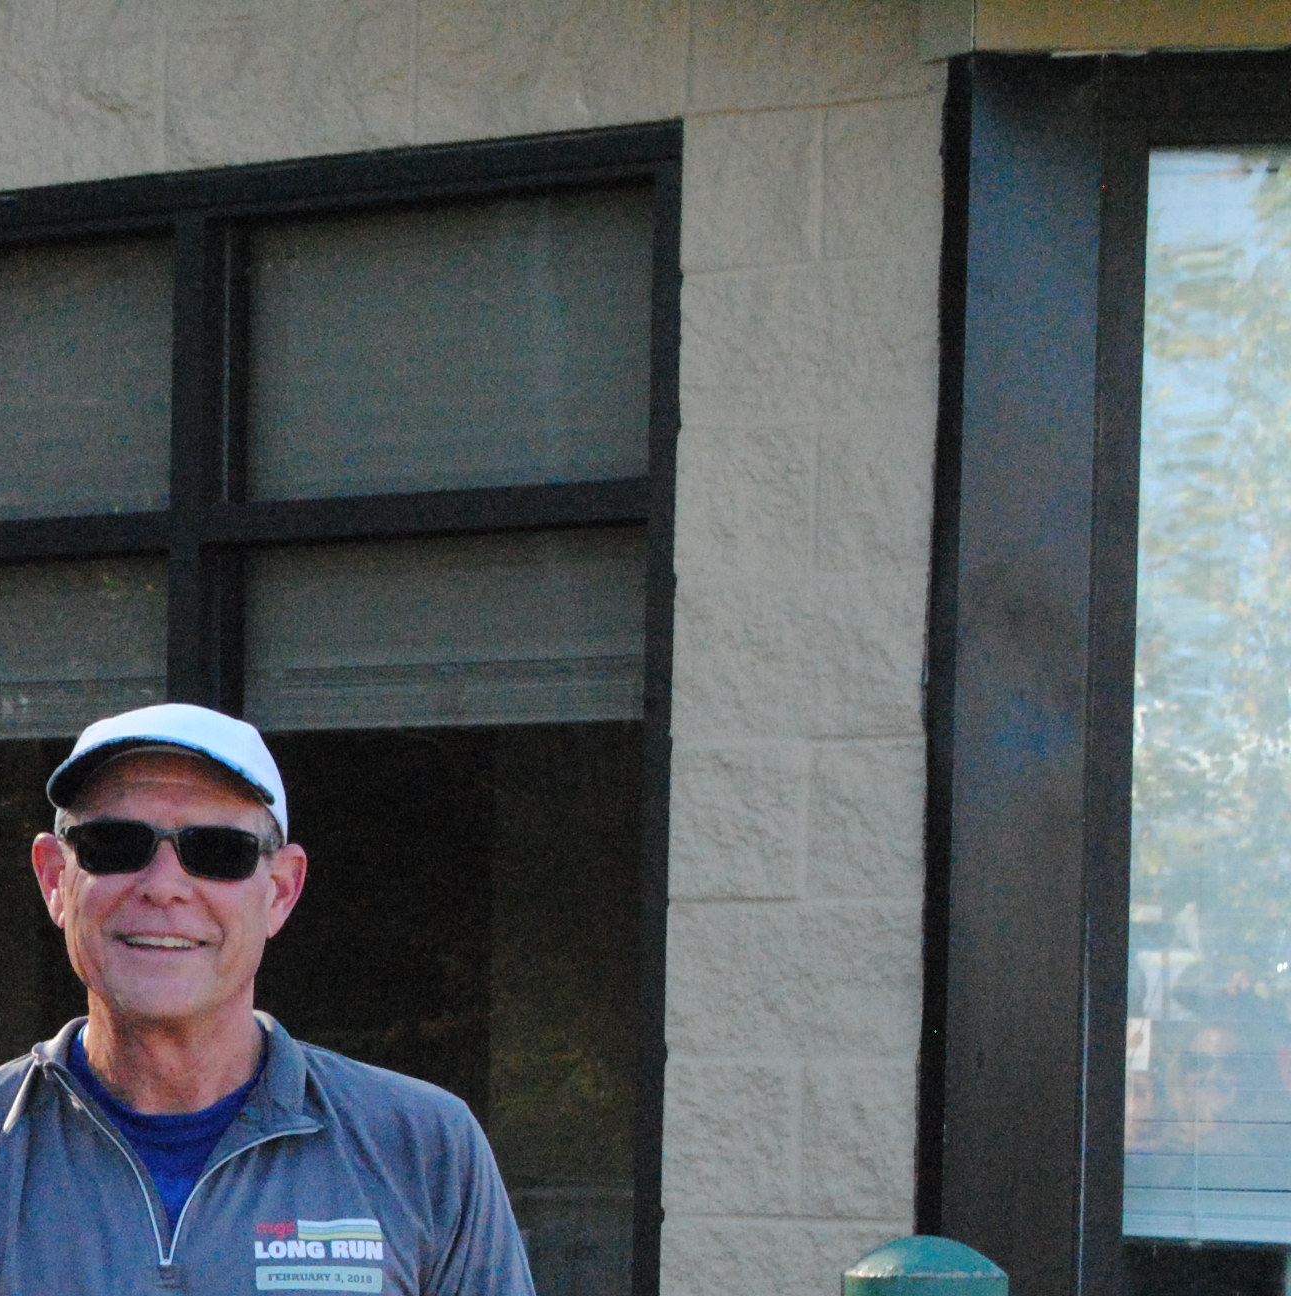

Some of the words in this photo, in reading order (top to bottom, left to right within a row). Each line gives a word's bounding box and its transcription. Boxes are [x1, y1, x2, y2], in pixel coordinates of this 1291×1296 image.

[255, 1240, 325, 1259] LONG
[331, 1240, 383, 1260] RUN
[268, 1273, 331, 1281] FEBRUARY
[347, 1274, 373, 1284] 2018
